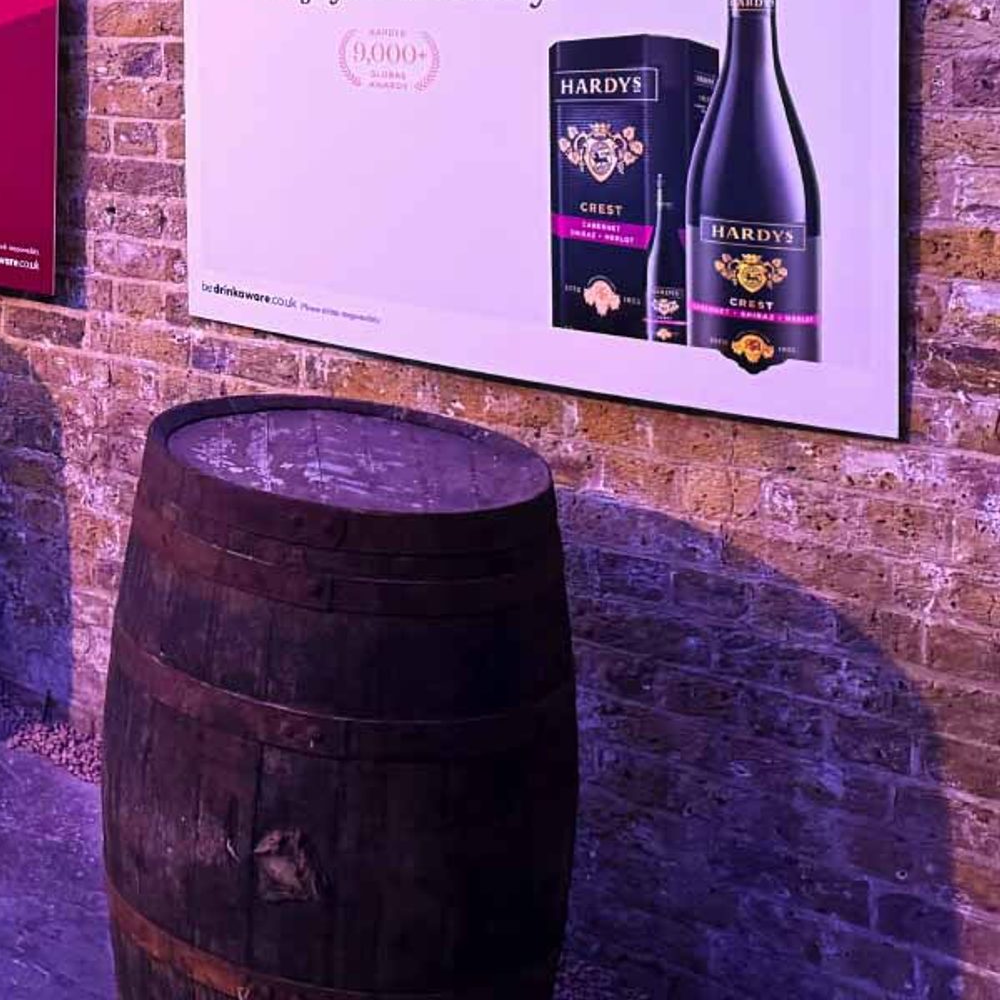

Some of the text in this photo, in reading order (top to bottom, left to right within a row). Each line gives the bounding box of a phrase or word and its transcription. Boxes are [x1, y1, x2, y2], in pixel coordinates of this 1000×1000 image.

[352, 40, 427, 66] 9,000+
[560, 76, 642, 95] HARDYS
[579, 202, 624, 216] CREST
[710, 224, 795, 244] HARDYS
[729, 297, 775, 311] CREST
